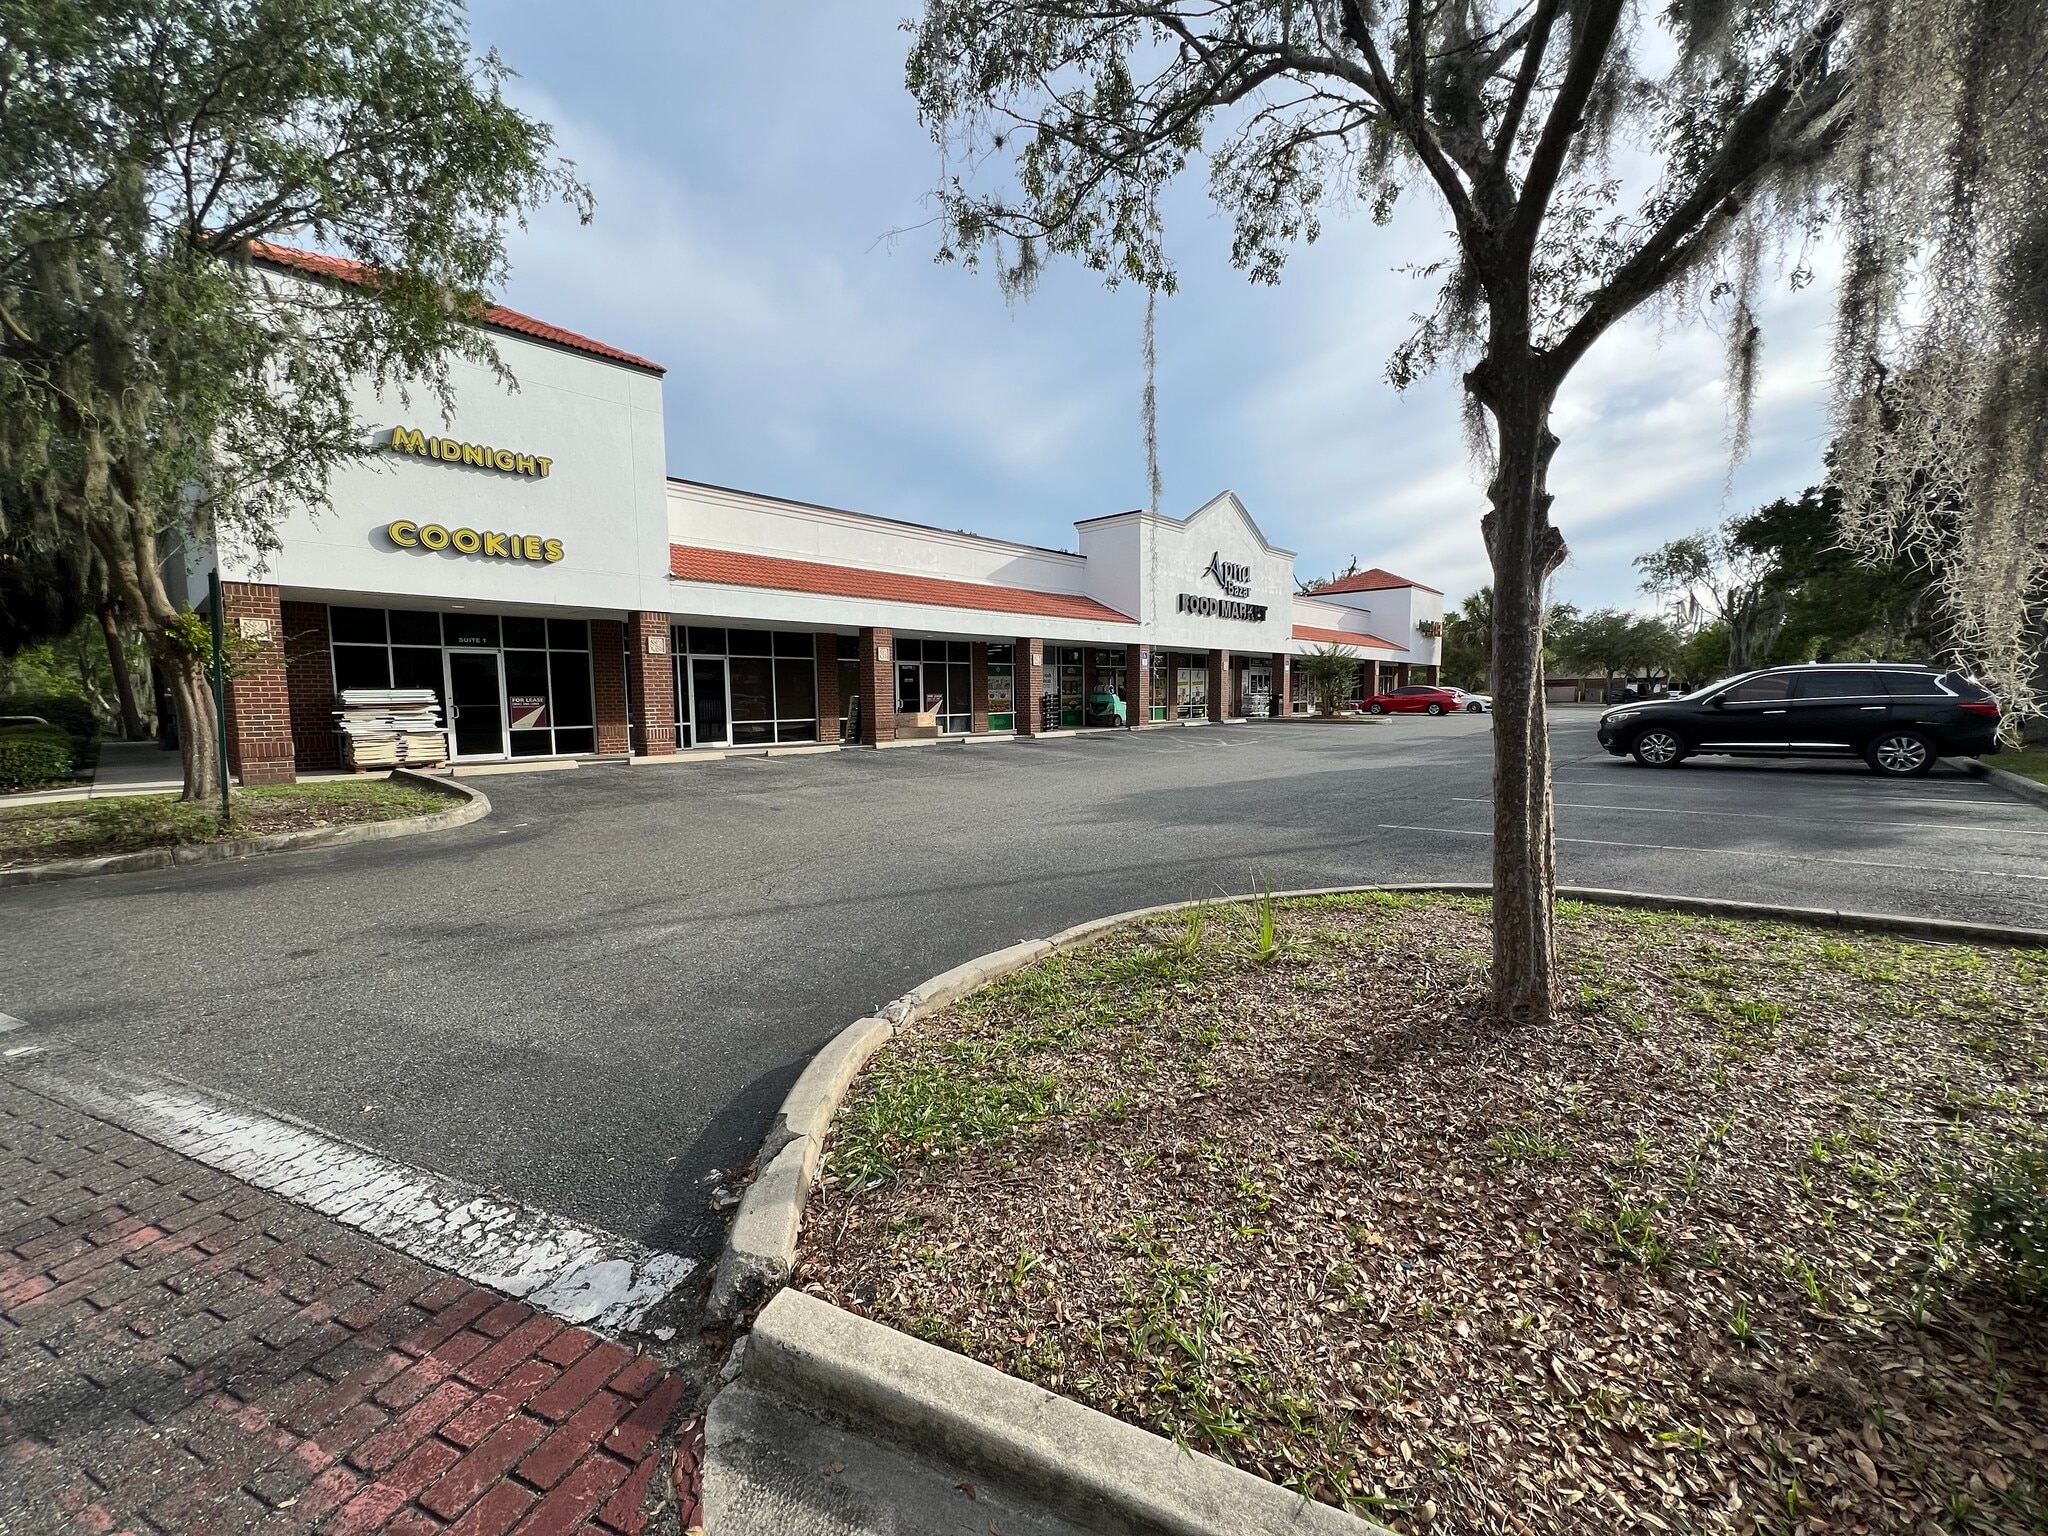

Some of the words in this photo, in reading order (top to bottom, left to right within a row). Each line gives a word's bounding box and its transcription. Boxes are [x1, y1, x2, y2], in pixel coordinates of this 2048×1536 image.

[391, 425, 554, 477] MIDNIGHT
[388, 519, 565, 562] COOKIES
[1201, 551, 1251, 589] Apna
[1226, 580, 1251, 598] Bazar
[1177, 593, 1218, 616] FOOD
